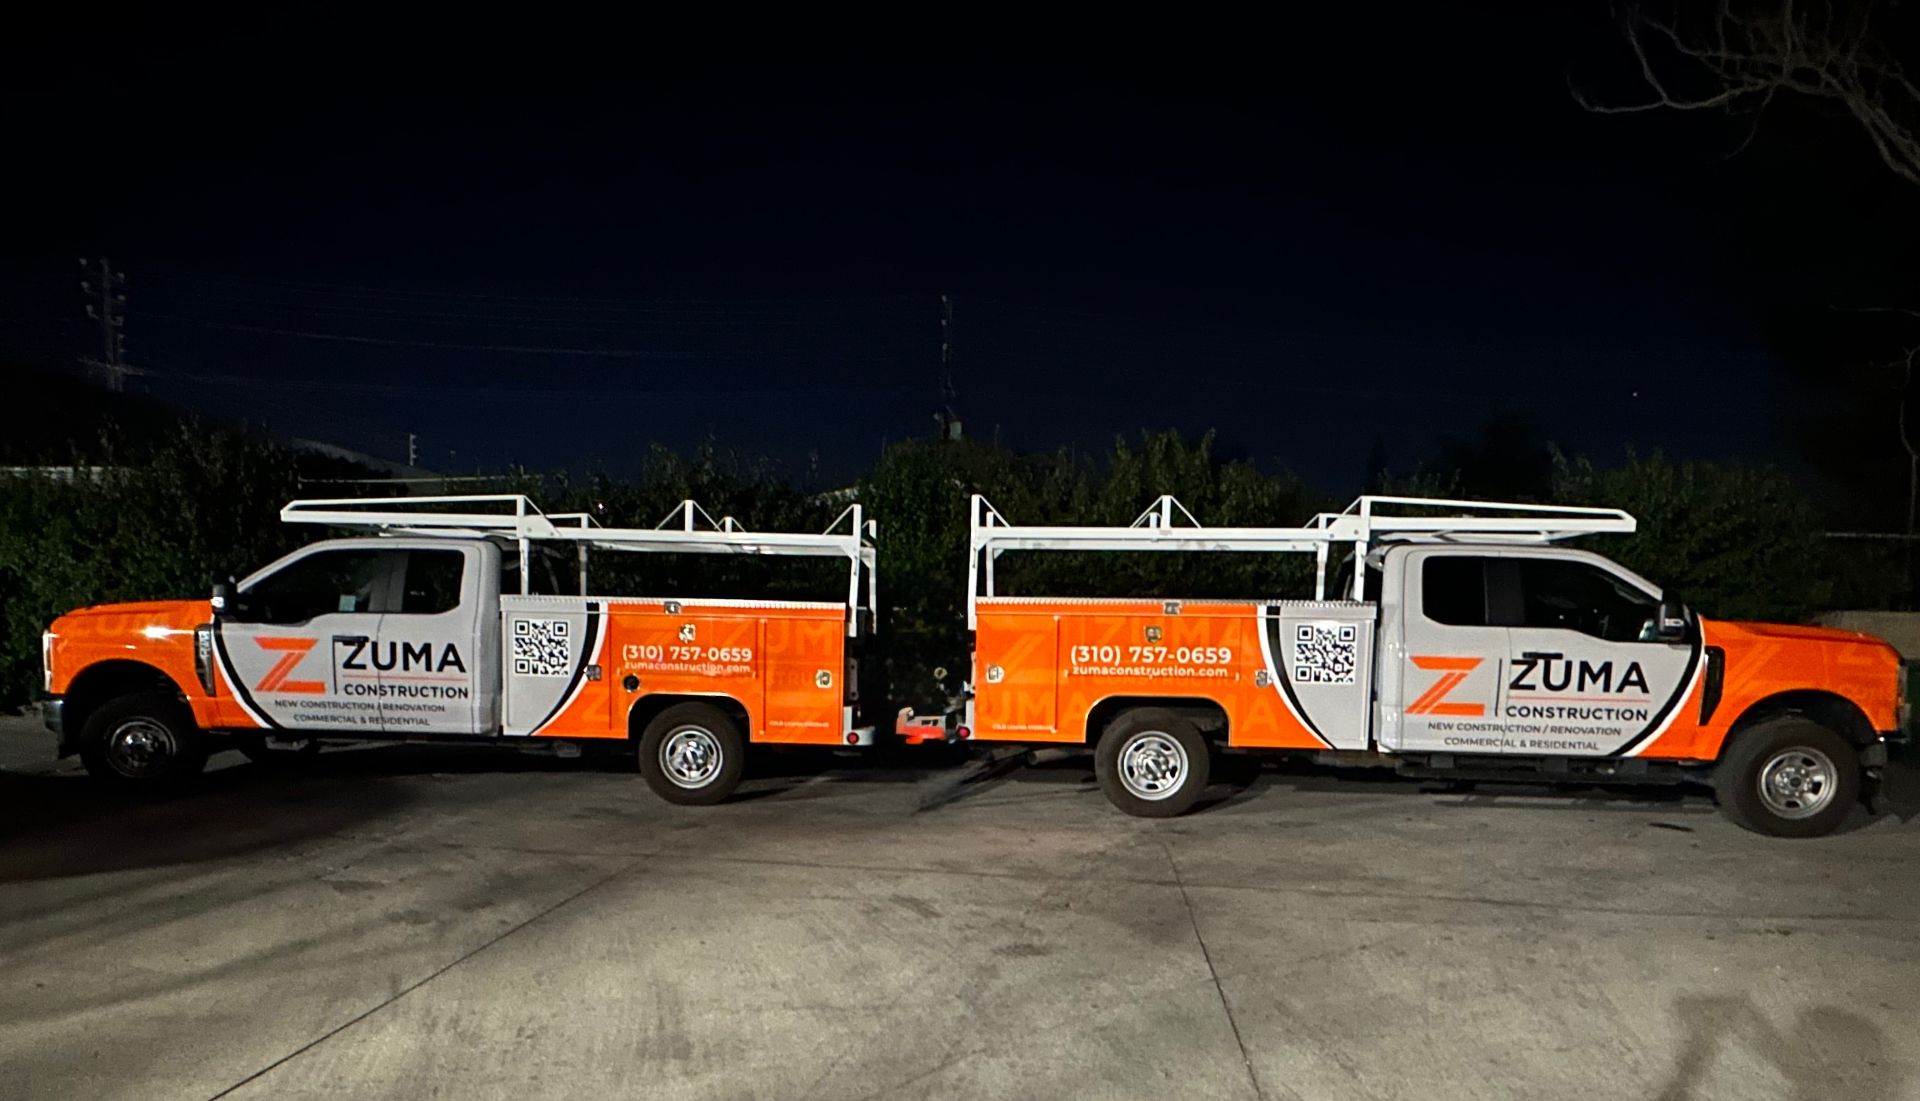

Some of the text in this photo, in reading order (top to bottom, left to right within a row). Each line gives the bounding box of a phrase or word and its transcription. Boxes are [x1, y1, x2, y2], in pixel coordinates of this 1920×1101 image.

[342, 638, 467, 674] ZUMA
[622, 644, 753, 663] (310) 757-0659
[1071, 645, 1232, 666] (310) 757-0659
[254, 636, 327, 695] Z
[624, 661, 751, 673] zumaconstruction.com
[1072, 664, 1228, 678] zumaconstruction.com
[1509, 658, 1651, 694] ZUMA
[343, 683, 469, 699] CONSTRUCTION
[1404, 655, 1485, 717] Z
[275, 699, 298, 708] NEW
[300, 700, 375, 711] CONSTRUCTION
[383, 702, 446, 713] RENOVATION
[1506, 705, 1648, 722] CONSTRUCTION
[293, 713, 431, 726] COMMERCIAL & RESIDENTIAL
[1428, 721, 1622, 736] NEW CONSTRUCTION / RENOVATION
[1444, 737, 1599, 751] COMMERCIAL & RESIDENTIAL
